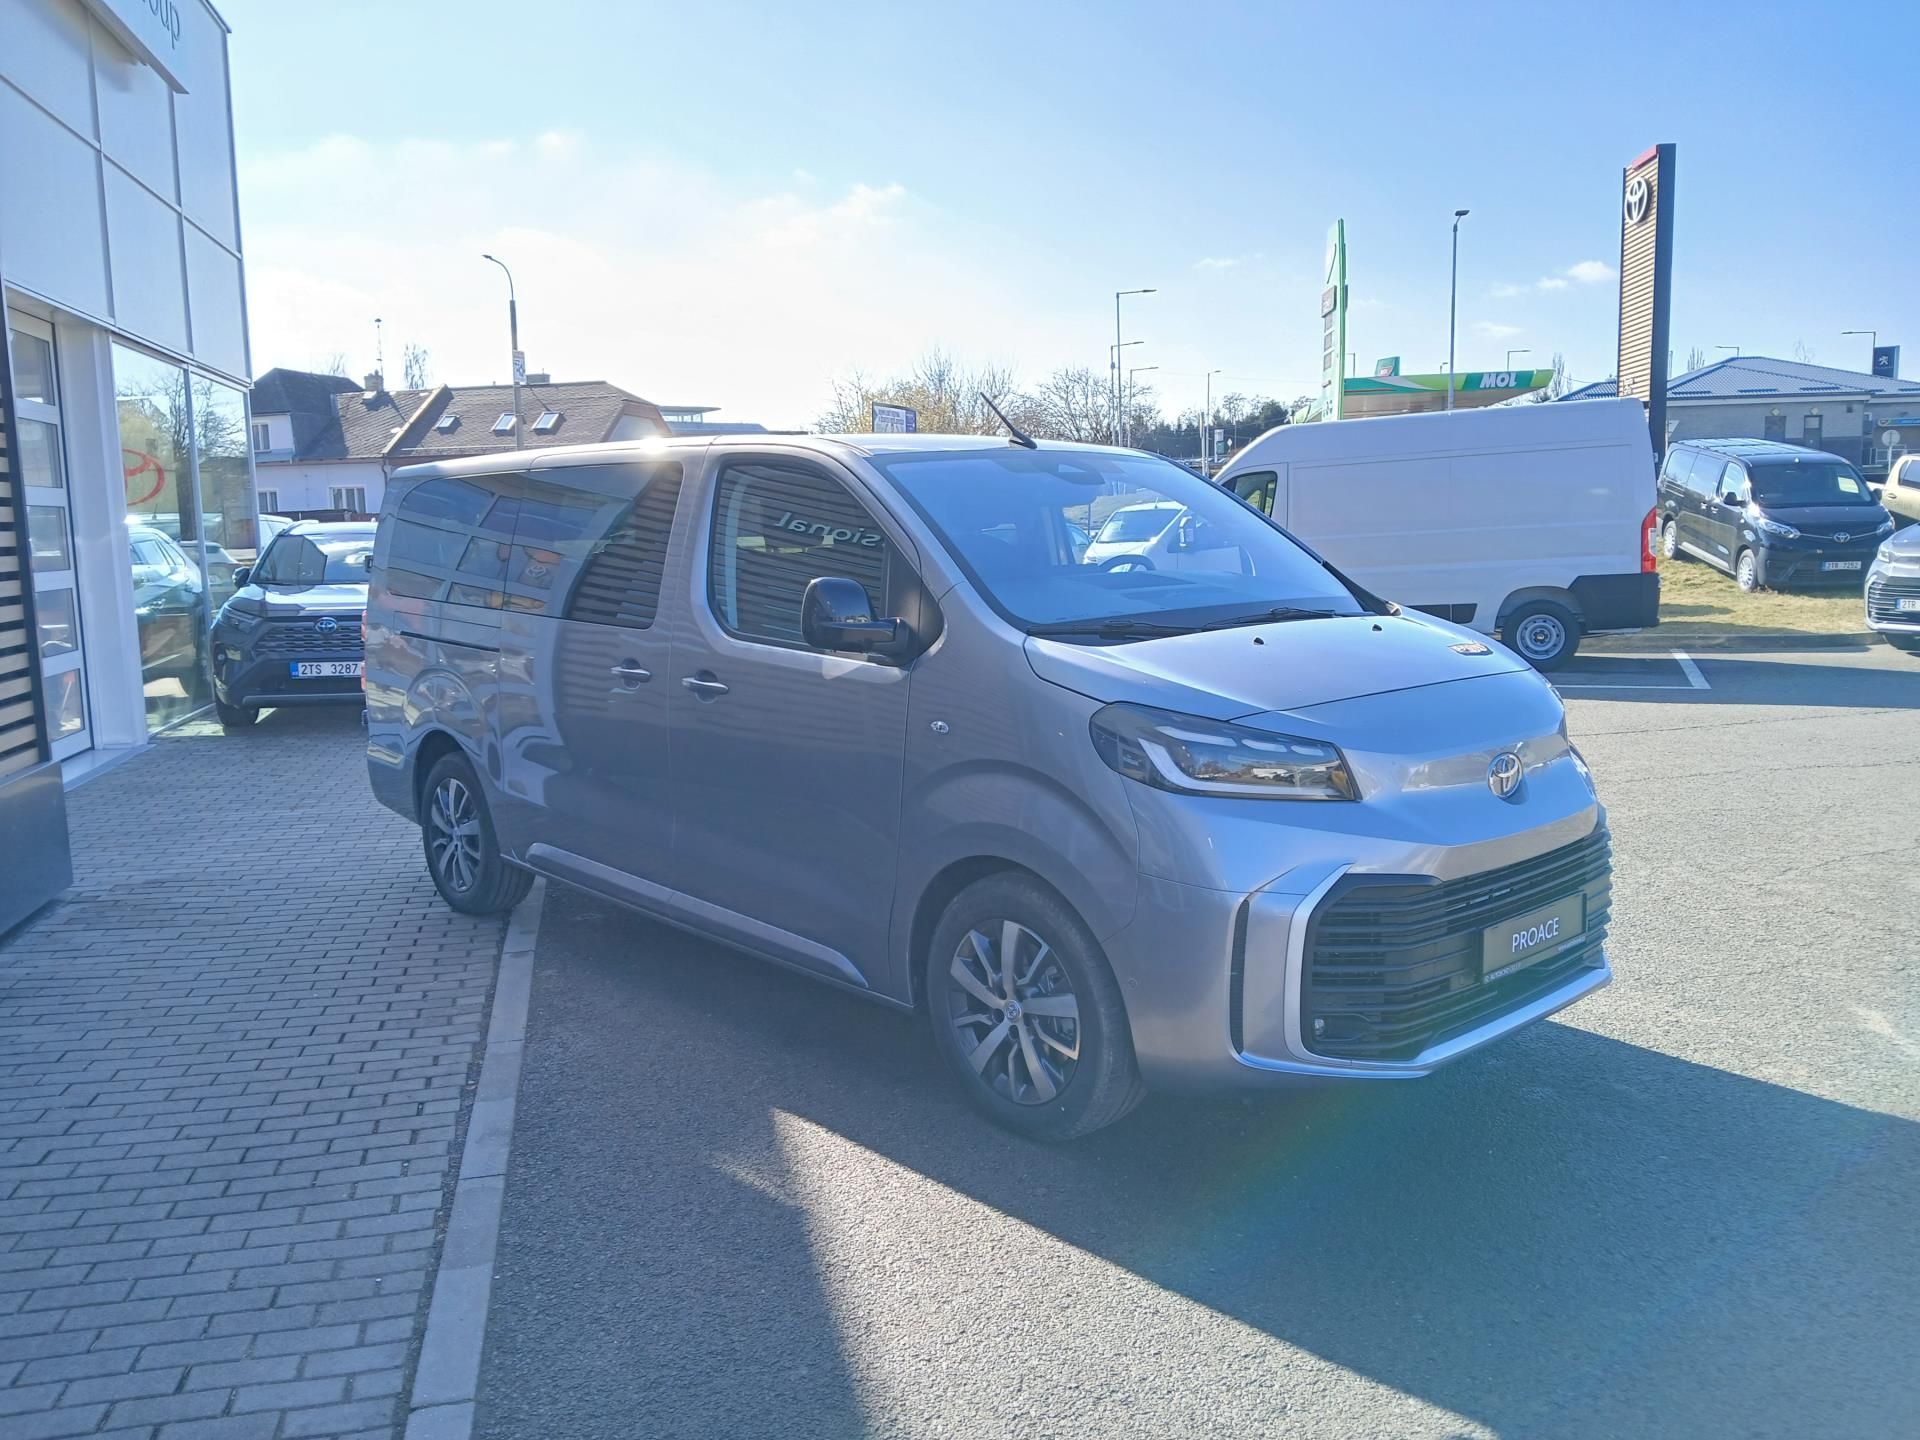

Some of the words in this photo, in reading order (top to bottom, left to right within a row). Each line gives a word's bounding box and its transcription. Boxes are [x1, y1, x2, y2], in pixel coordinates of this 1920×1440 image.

[141, 0, 180, 50] oup
[1480, 372, 1517, 388] MOL
[301, 664, 322, 675] 2TS
[330, 663, 358, 674] 3287
[1511, 917, 1560, 953] PROACE
